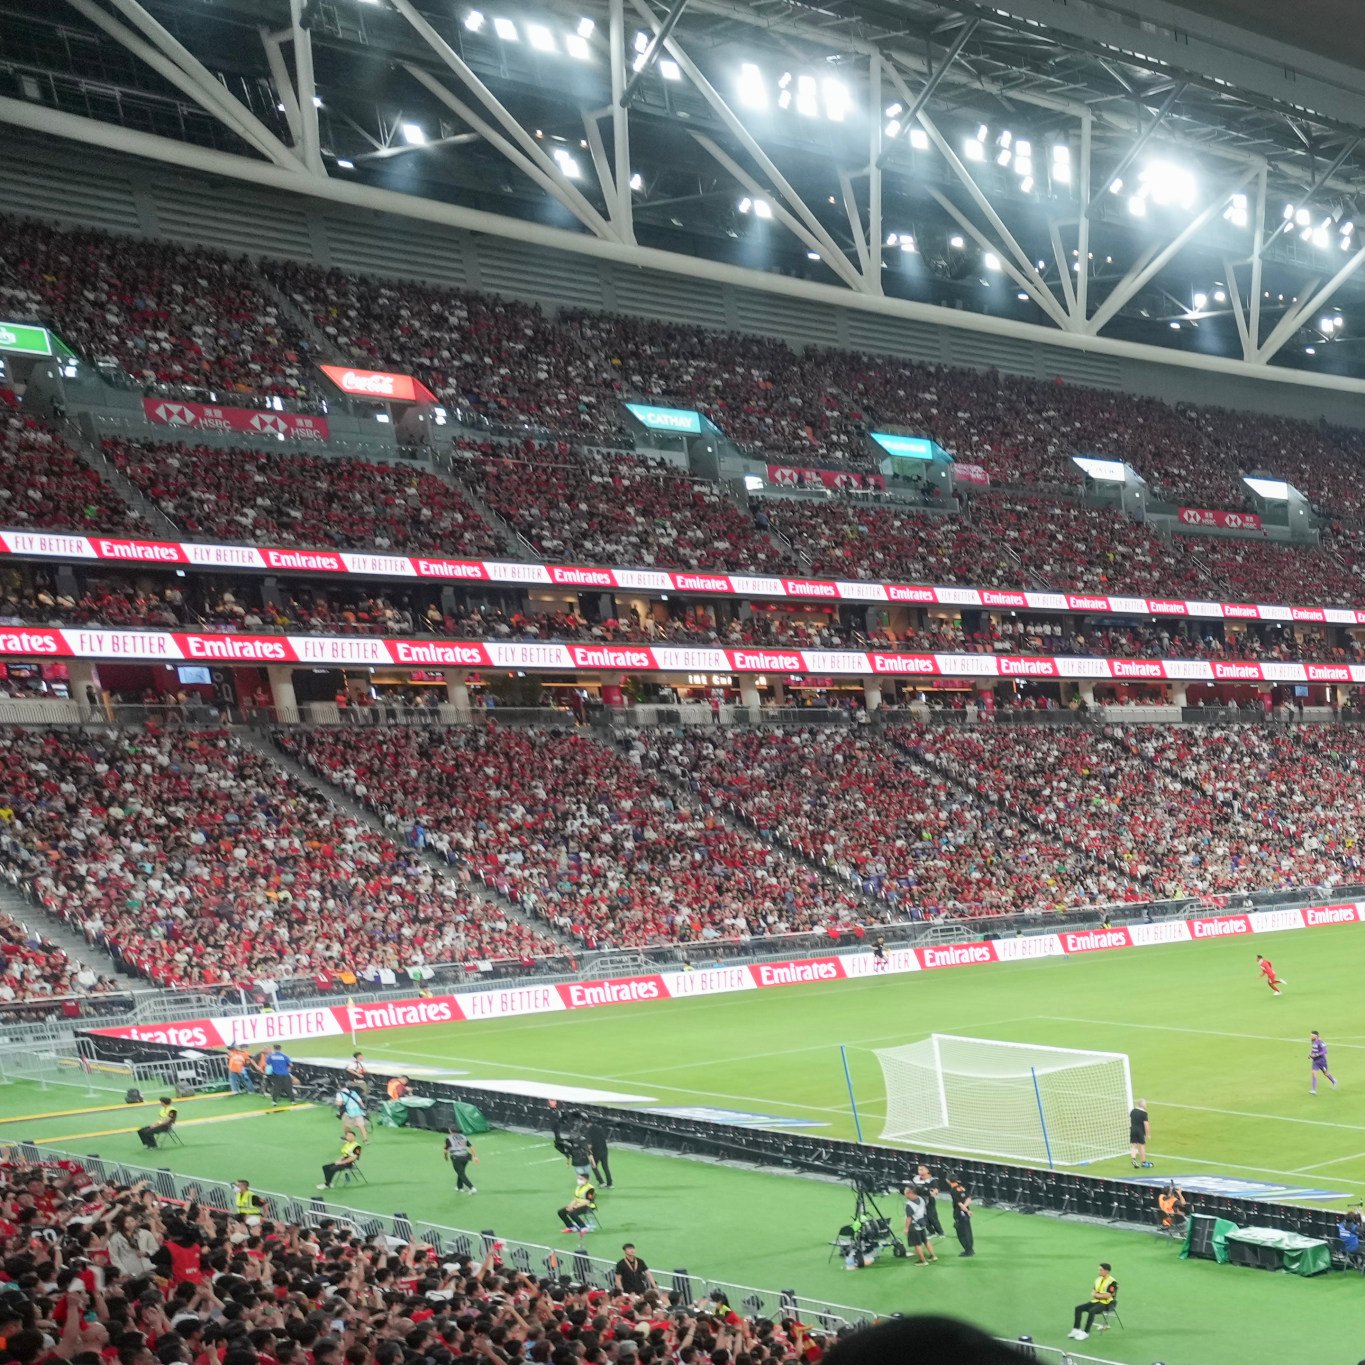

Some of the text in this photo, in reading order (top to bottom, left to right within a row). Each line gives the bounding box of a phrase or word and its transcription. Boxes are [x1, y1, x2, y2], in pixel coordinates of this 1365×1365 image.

[200, 417, 230, 431] HSBC
[647, 413, 692, 429] CATHAY
[291, 426, 321, 439] HSBC
[15, 536, 83, 553] FLY BETTER
[101, 541, 178, 560] Emirates
[194, 547, 254, 563] FLY BETTER
[270, 552, 338, 569] Emirates
[352, 556, 405, 572] FLY BETTER
[419, 560, 481, 577] Emirates
[494, 565, 541, 579] FLY BETTER
[554, 568, 610, 583] Emirates
[622, 573, 666, 586] FLY BETTER
[676, 575, 728, 591] Emirates
[738, 580, 778, 592] FLY BETTER
[788, 581, 835, 597] Emirates
[890, 587, 933, 602] Emirates
[983, 591, 1024, 606] Emirates
[1070, 596, 1108, 610] Emirates
[1151, 601, 1186, 614] Emirates
[1224, 605, 1257, 618] Emirates
[1293, 608, 1323, 621] Emirates
[0, 633, 57, 653] rates
[80, 634, 166, 654] FLY BETTER
[187, 637, 285, 658] Emirates
[304, 641, 378, 660] FLY BETTER
[396, 643, 481, 662] Emirates
[498, 646, 562, 664] FLY BETTER
[575, 648, 648, 667] Emirates
[663, 650, 720, 667] FLY BETTER
[734, 652, 799, 670] Emirates
[812, 653, 863, 669] FLY BETTER
[875, 656, 933, 672] Emirates
[1001, 658, 1053, 674] Emirates
[1113, 661, 1161, 676] Emirates
[1216, 664, 1259, 678] Emirates
[1308, 666, 1348, 680] Emirates
[1257, 911, 1298, 929] FLY BETTER
[1307, 909, 1354, 925] Emirates
[1137, 923, 1183, 942] FLY BETTER
[1194, 918, 1246, 937] Emirates
[1003, 937, 1055, 957] FLY BETTER
[1067, 931, 1126, 951] Emirates
[924, 946, 991, 967] Emirates
[760, 961, 837, 985] Emirates
[852, 957, 868, 974] FLY
[676, 969, 744, 993] FLY BETTER
[471, 988, 550, 1014] FLY BETTER
[569, 980, 659, 1006] Emirates
[349, 1001, 452, 1031] Emirates
[231, 1011, 325, 1041] FLY BETTER
